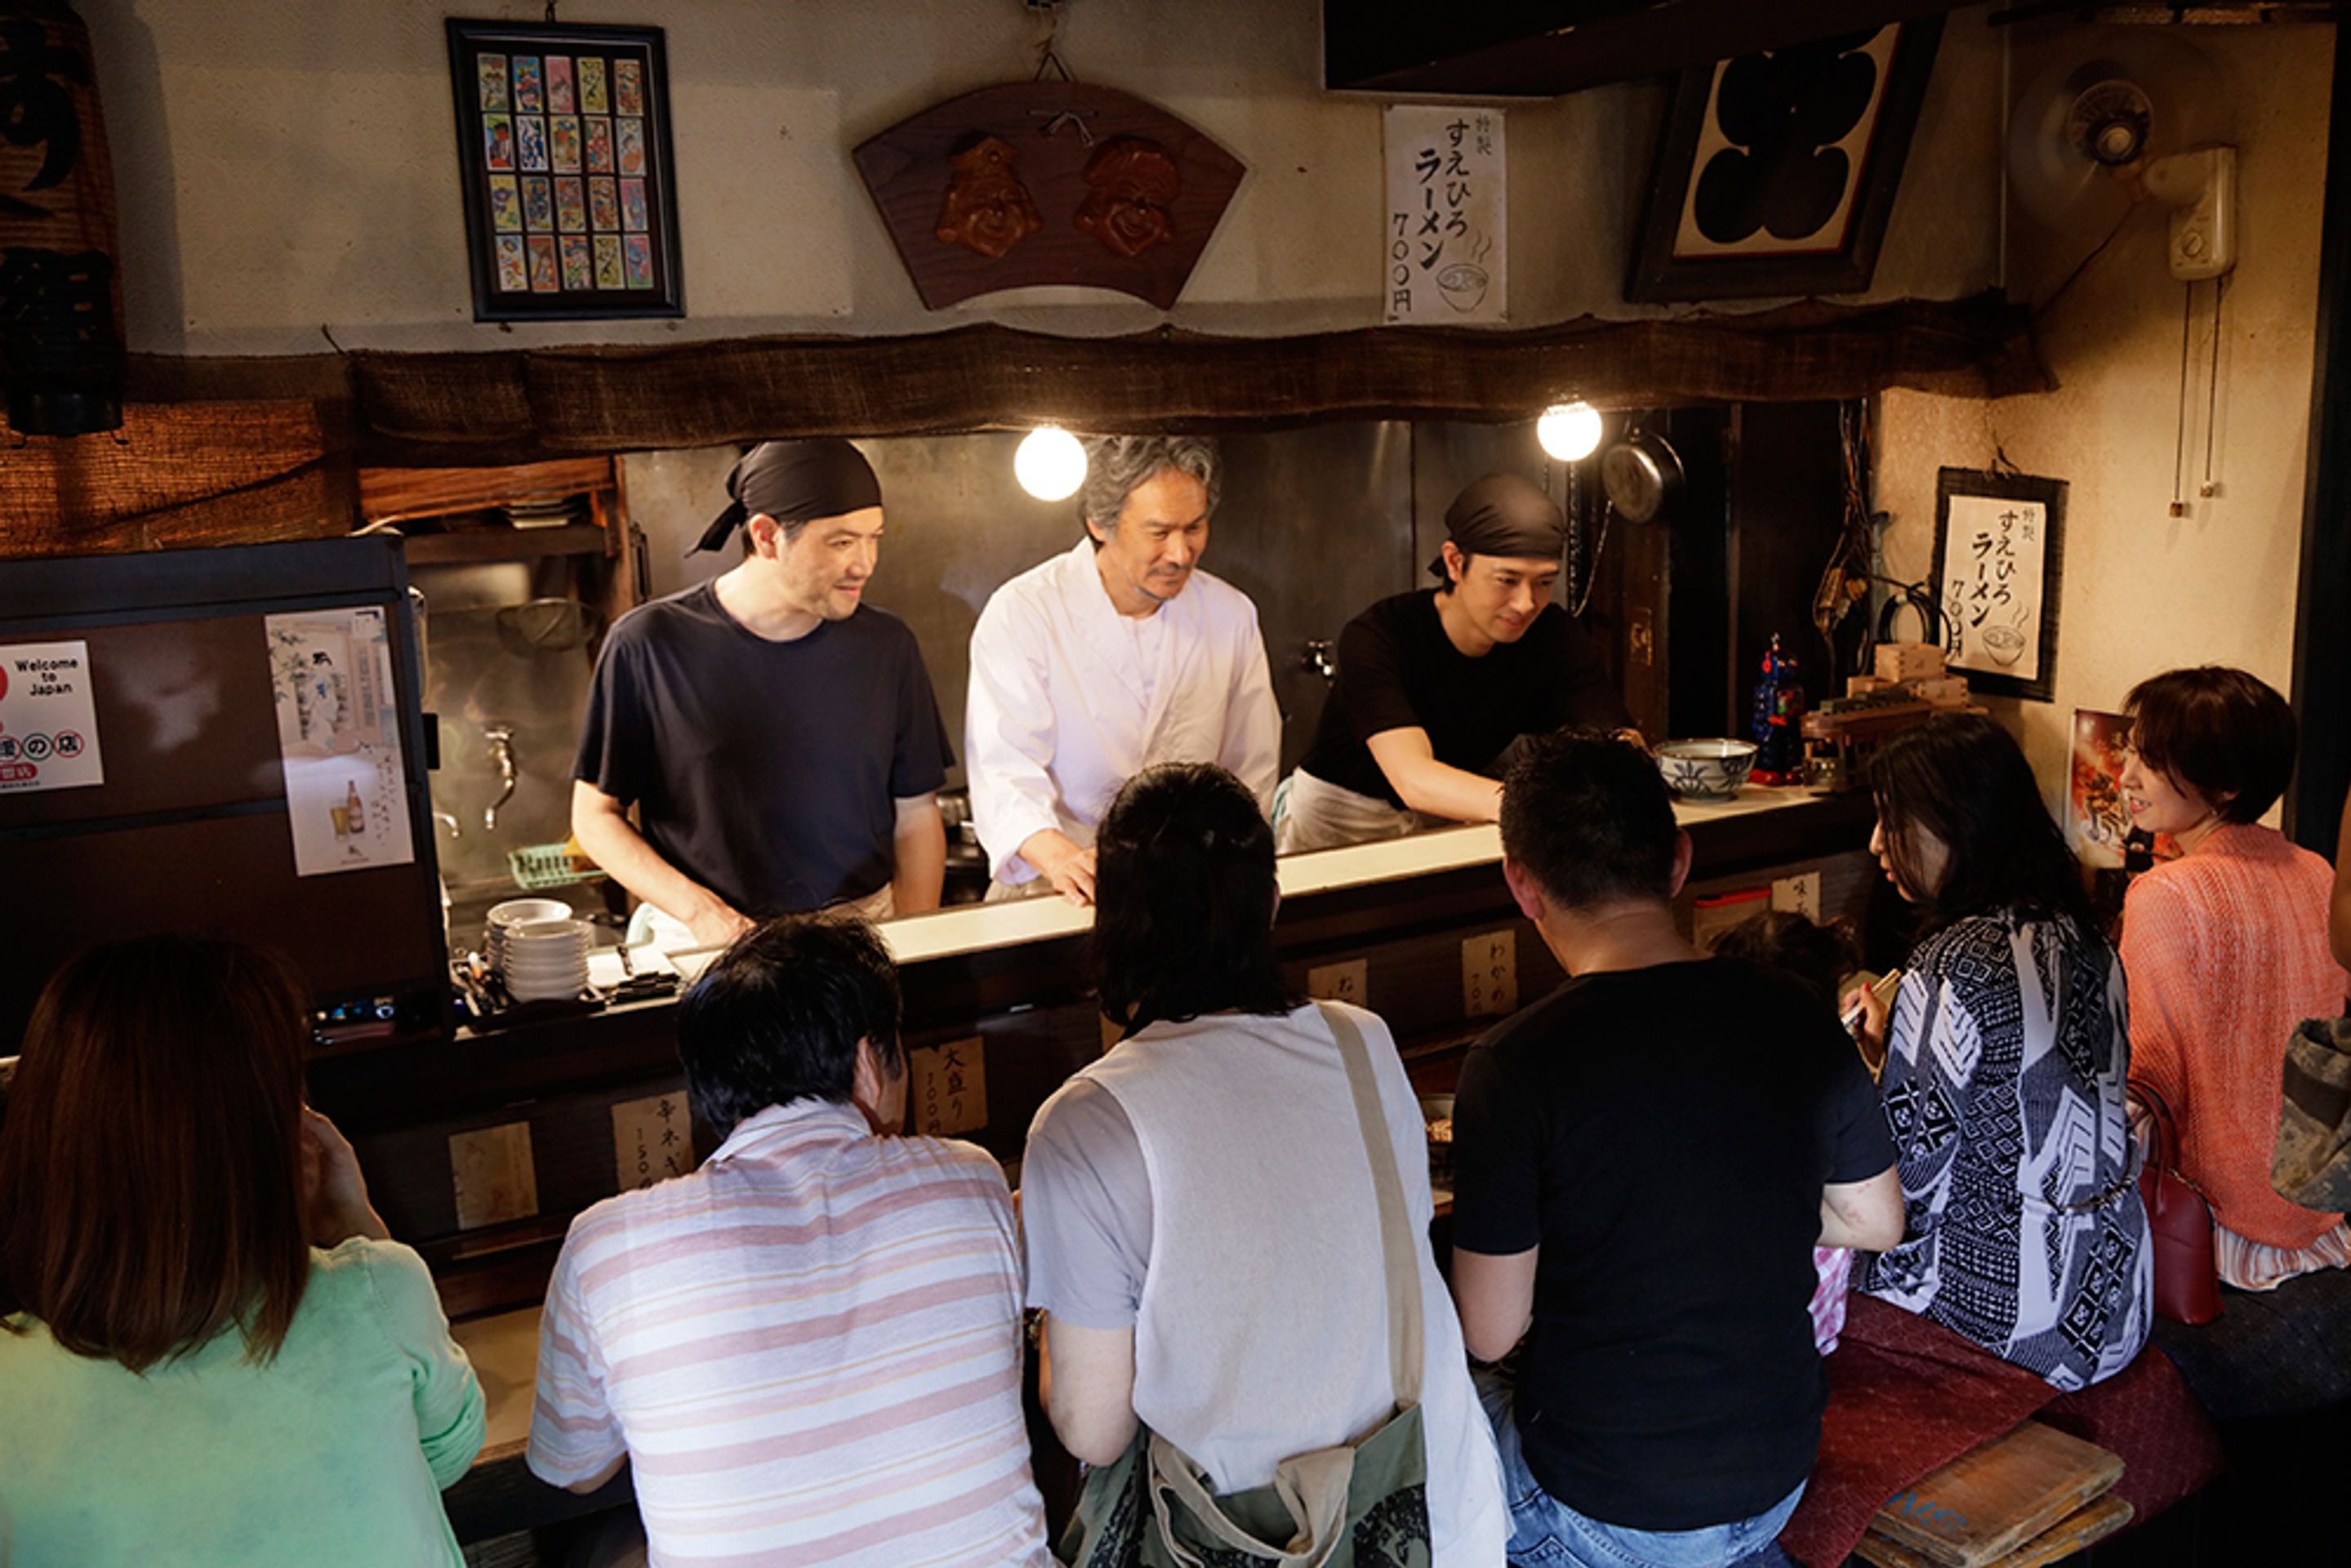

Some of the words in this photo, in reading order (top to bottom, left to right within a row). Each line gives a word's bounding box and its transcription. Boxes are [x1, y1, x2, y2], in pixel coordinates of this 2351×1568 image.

[1415, 148, 1444, 270] ラーメン
[1445, 118, 1472, 238] すえひろ
[1970, 532, 1993, 628] ラーメン
[1993, 509, 2019, 606] すえひろ
[15, 658, 79, 672] Welcome
[29, 683, 73, 697] Japan
[42, 671, 58, 683] to
[942, 1047, 967, 1121] 大盛り
